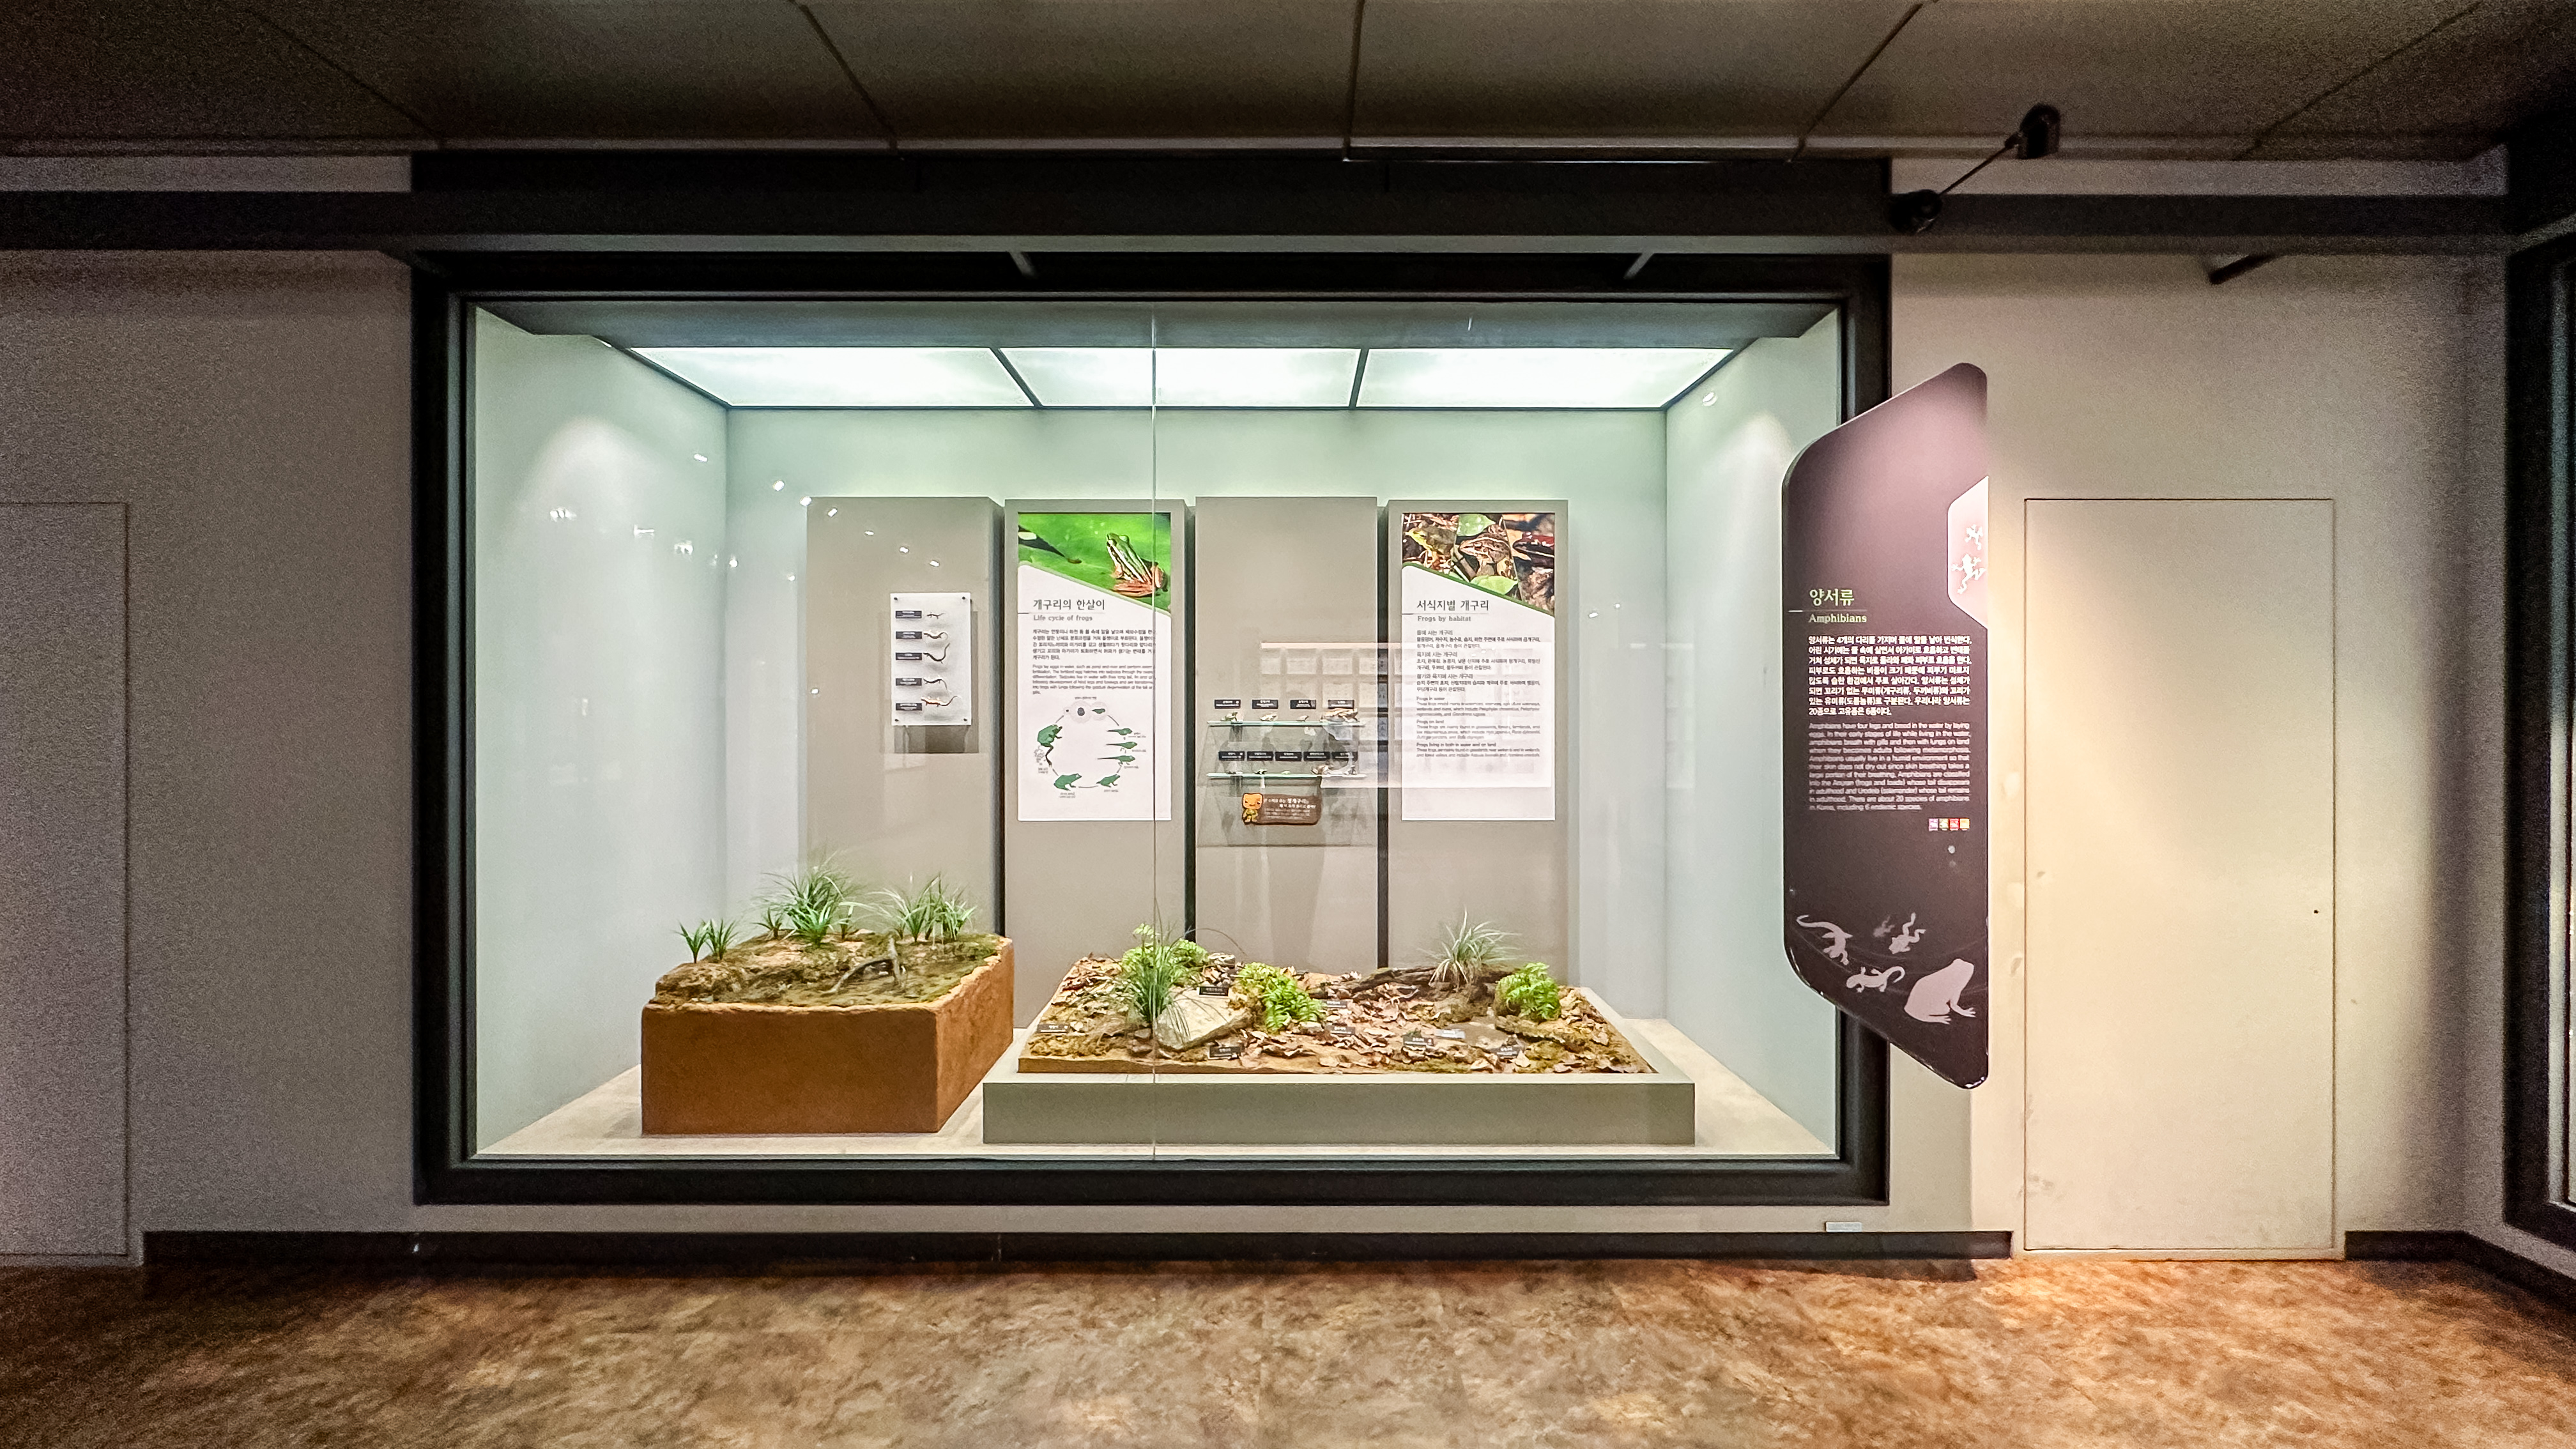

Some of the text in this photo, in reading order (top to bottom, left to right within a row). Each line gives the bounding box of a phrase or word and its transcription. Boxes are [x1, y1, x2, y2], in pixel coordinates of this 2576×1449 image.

[1809, 588, 1854, 606] 양서류
[1033, 599, 1105, 611] 개구리의 한살이
[1417, 599, 1489, 611] 서식지별 개구리
[1808, 614, 1867, 624] Amphibians
[1809, 635, 1835, 645] 양서류는
[1836, 635, 1854, 645] 4개의
[1855, 635, 1876, 645] 다리를
[1877, 635, 1897, 645] 가지며
[1898, 635, 1913, 645] 물에
[1913, 635, 1928, 645] 알을
[1928, 635, 1943, 645] 낳아
[1809, 645, 1822, 655] 어린
[1823, 645, 1850, 655] 시기에는
[1851, 645, 1859, 655] 물
[1860, 645, 1873, 655] 속에
[1874, 645, 1894, 655] 살면서
[1895, 645, 1922, 655] 아가미로
[1922, 645, 1950, 655] 호흡하고
[1809, 656, 1822, 665] 거쳐
[1823, 656, 1843, 665] 성체가
[1844, 656, 1858, 665] 되면
[1859, 656, 1879, 665] 육지로
[1880, 656, 1900, 665] 올라와
[1915, 656, 1935, 665] 피부로
[1935, 656, 1956, 665] 호흡을
[1956, 656, 1972, 665] 한다.
[1809, 666, 1970, 675] 피부로도 호흡하는 비중이 크기 때문에 피부가 마르지
[1809, 676, 1970, 686] 않도록 습한 환경에서 주로 살아간다. 양서류는 성체가
[1809, 686, 1823, 696] 되면
[1824, 686, 1844, 696] 꼬리가
[1846, 686, 1860, 696] 없는
[1949, 686, 1970, 696] 꼬리가
[1809, 696, 1823, 706] 있는
[1883, 696, 1913, 706] 구분된다.
[1914, 696, 1942, 706] 우리나라
[1942, 696, 1970, 706] 양서류는
[1809, 707, 1892, 716] 20종으로 고유종은 6종이다.
